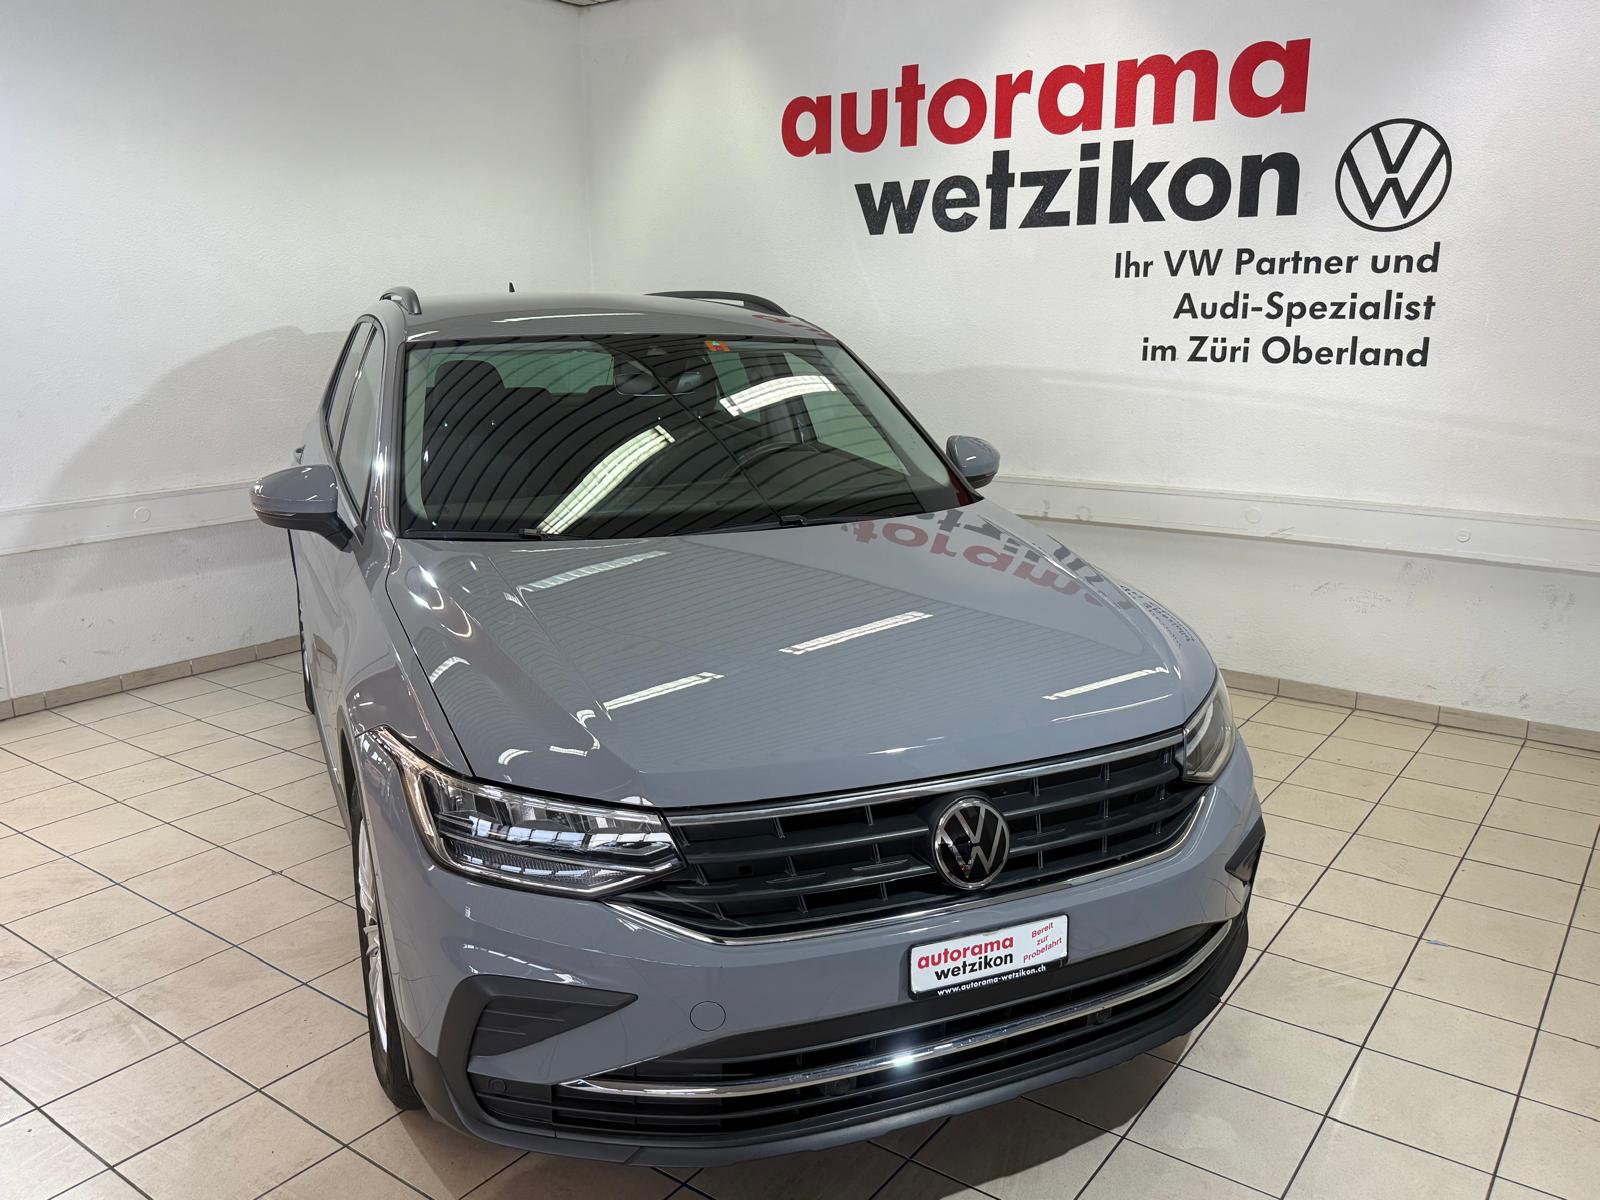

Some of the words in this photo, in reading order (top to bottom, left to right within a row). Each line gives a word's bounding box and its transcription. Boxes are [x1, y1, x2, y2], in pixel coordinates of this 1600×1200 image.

[781, 38, 1312, 158] autorama
[854, 139, 1301, 236] wetzikon
[1114, 250, 1154, 279] Ihr
[1163, 248, 1224, 277] VW
[1235, 247, 1359, 276] Partner
[1370, 241, 1441, 274] und
[1172, 289, 1436, 328] Audi-Spezialist
[1141, 337, 1177, 362] im
[1187, 335, 1250, 363] Züri
[1261, 335, 1430, 367] Oberland
[1031, 922, 1054, 938] Bereit
[1036, 934, 1049, 946] zur
[917, 936, 1014, 969] autorama
[1023, 937, 1063, 964] Probefahrt
[934, 953, 1014, 981] wetzikon
[937, 964, 1046, 996] www.autorama-wetzikon.ch
